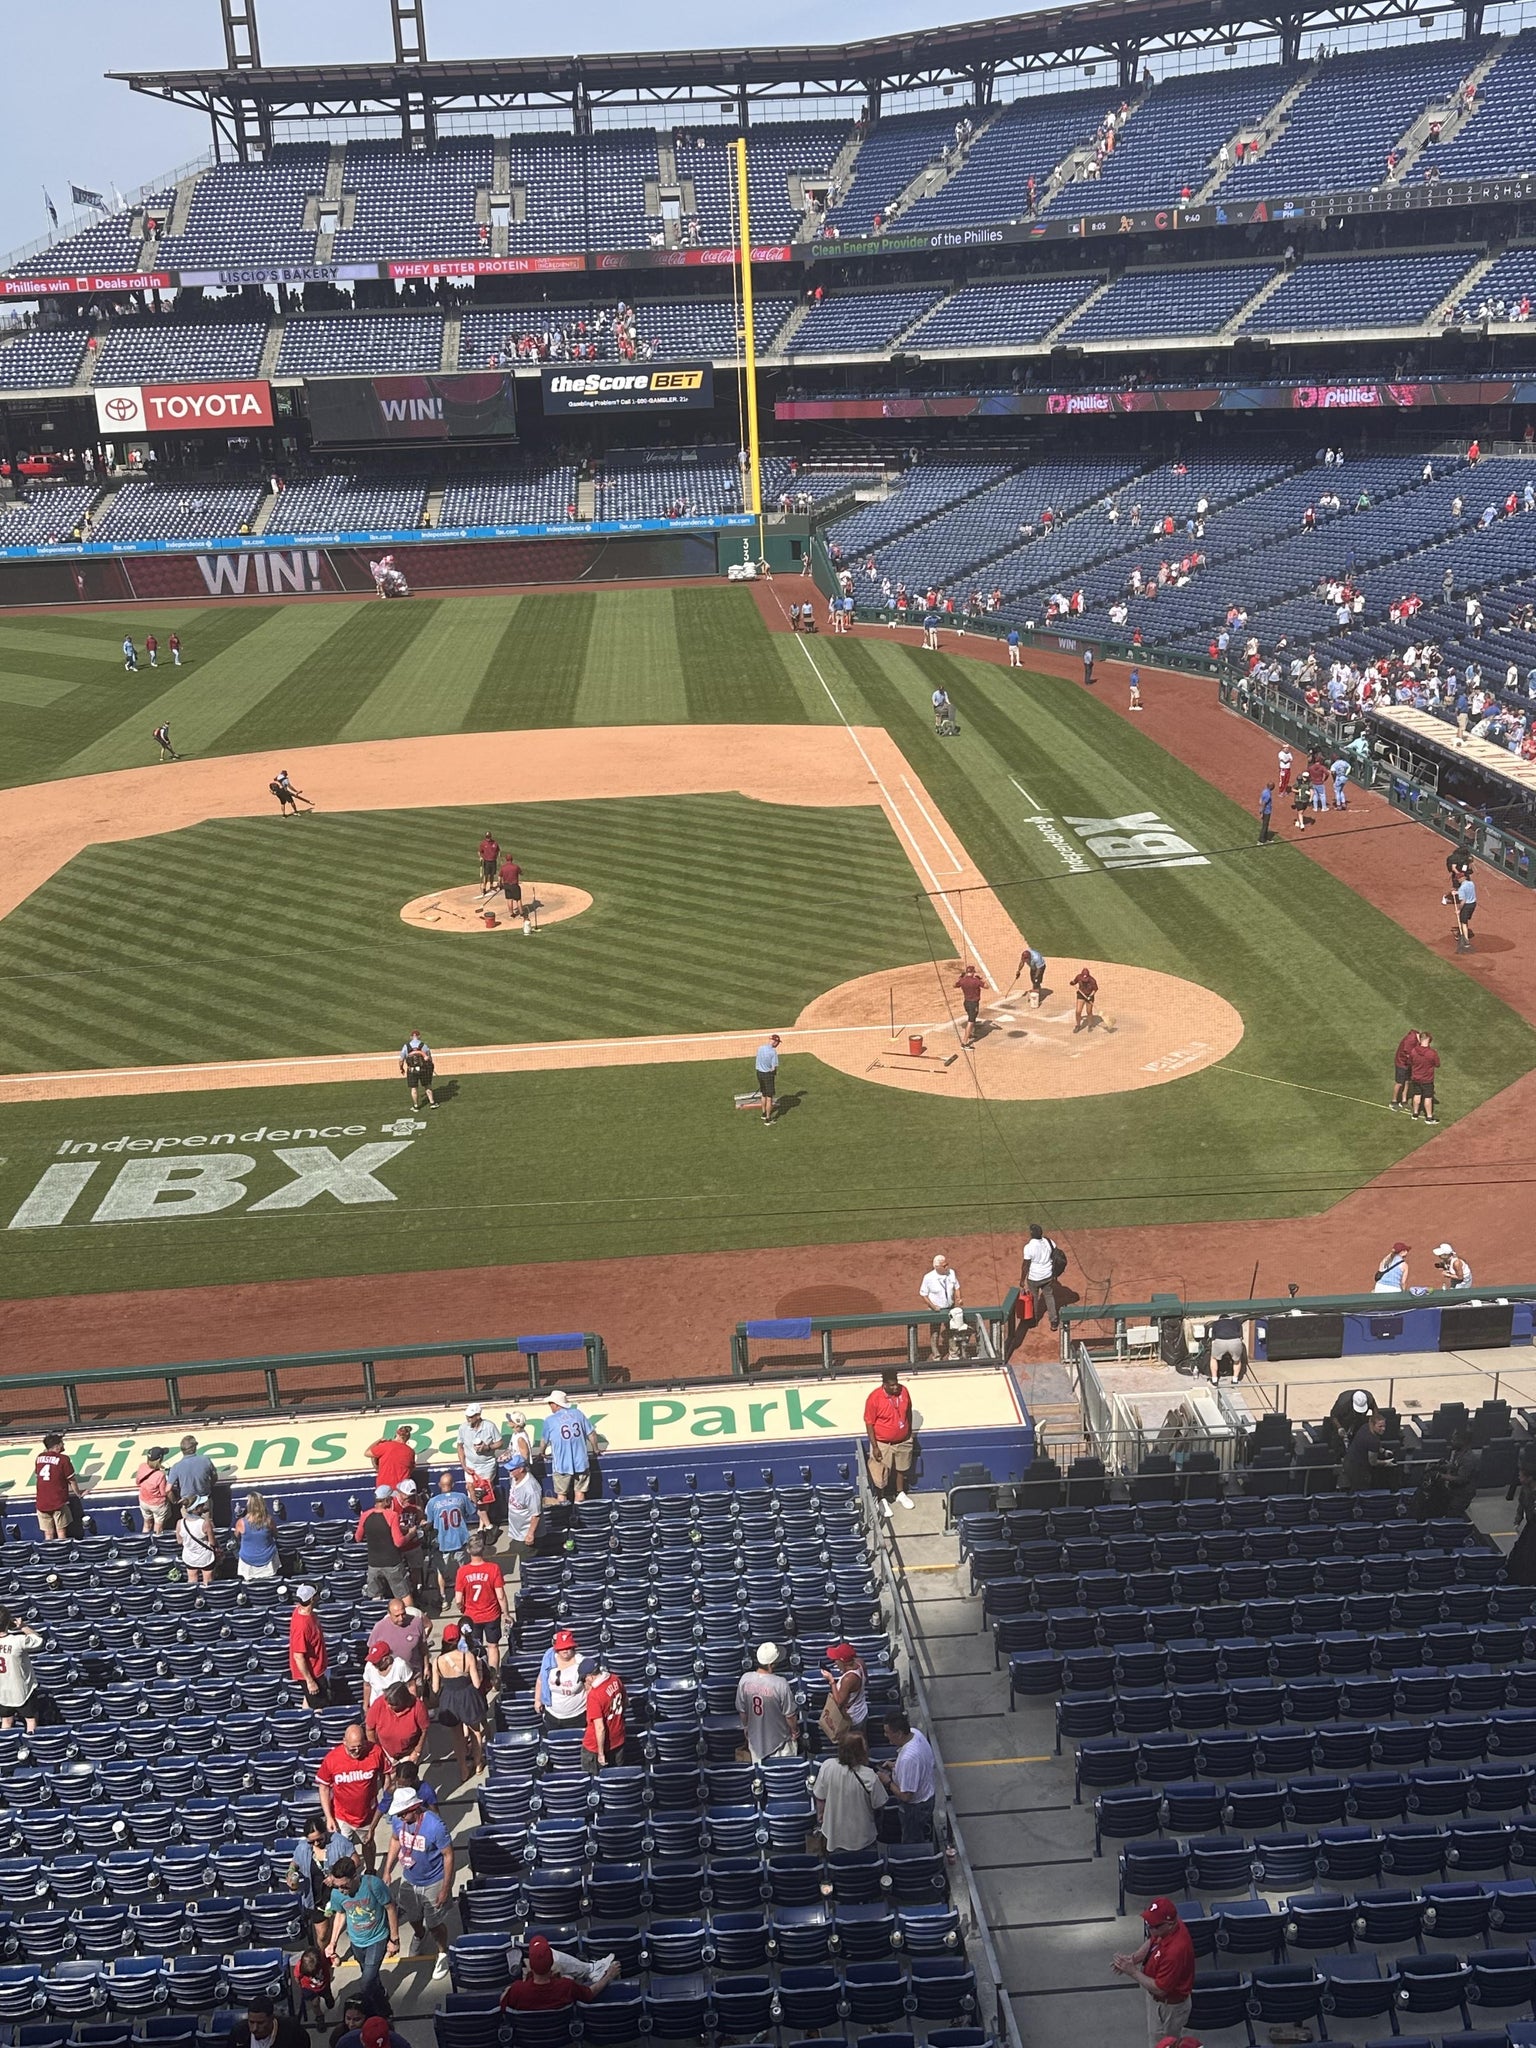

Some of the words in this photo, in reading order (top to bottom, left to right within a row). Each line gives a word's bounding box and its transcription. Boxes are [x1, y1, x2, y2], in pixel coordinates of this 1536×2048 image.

[1483, 187, 1490, 197] R
[1503, 186, 1511, 195] H
[1282, 210, 1295, 219] PHI
[1283, 201, 1294, 210] SD
[812, 242, 842, 257] Clean
[843, 240, 880, 255] Energy
[882, 236, 928, 251] Provider
[930, 233, 942, 247] of
[944, 232, 962, 245] the
[964, 228, 1003, 244] Phillies
[220, 269, 279, 283] LISCIO'S
[283, 267, 338, 280] BAKERY
[394, 263, 430, 275] WHEY
[433, 262, 475, 274] BETTER
[478, 260, 529, 272] PROTEIN
[5, 280, 47, 293] Phillies
[48, 280, 70, 291] win
[94, 278, 128, 289] Deals
[129, 277, 149, 288] roll
[149, 276, 161, 287] in
[550, 373, 649, 394] theScore
[654, 373, 698, 389] BET
[149, 393, 262, 419] TOYOTA
[380, 397, 444, 422] WIN!
[195, 550, 322, 595] WIN!
[1058, 637, 1077, 651] WIN!
[1062, 811, 1212, 869] IBX
[56, 1122, 367, 1155] Independence
[7, 1141, 415, 1229] IBX
[638, 1389, 838, 1441] Park
[560, 1422, 581, 1440] 63
[39, 1463, 51, 1481] 4
[439, 1507, 462, 1531] 10
[471, 1584, 482, 1602] 7
[752, 1695, 764, 1717] 8
[334, 1769, 375, 1785] Phillies
